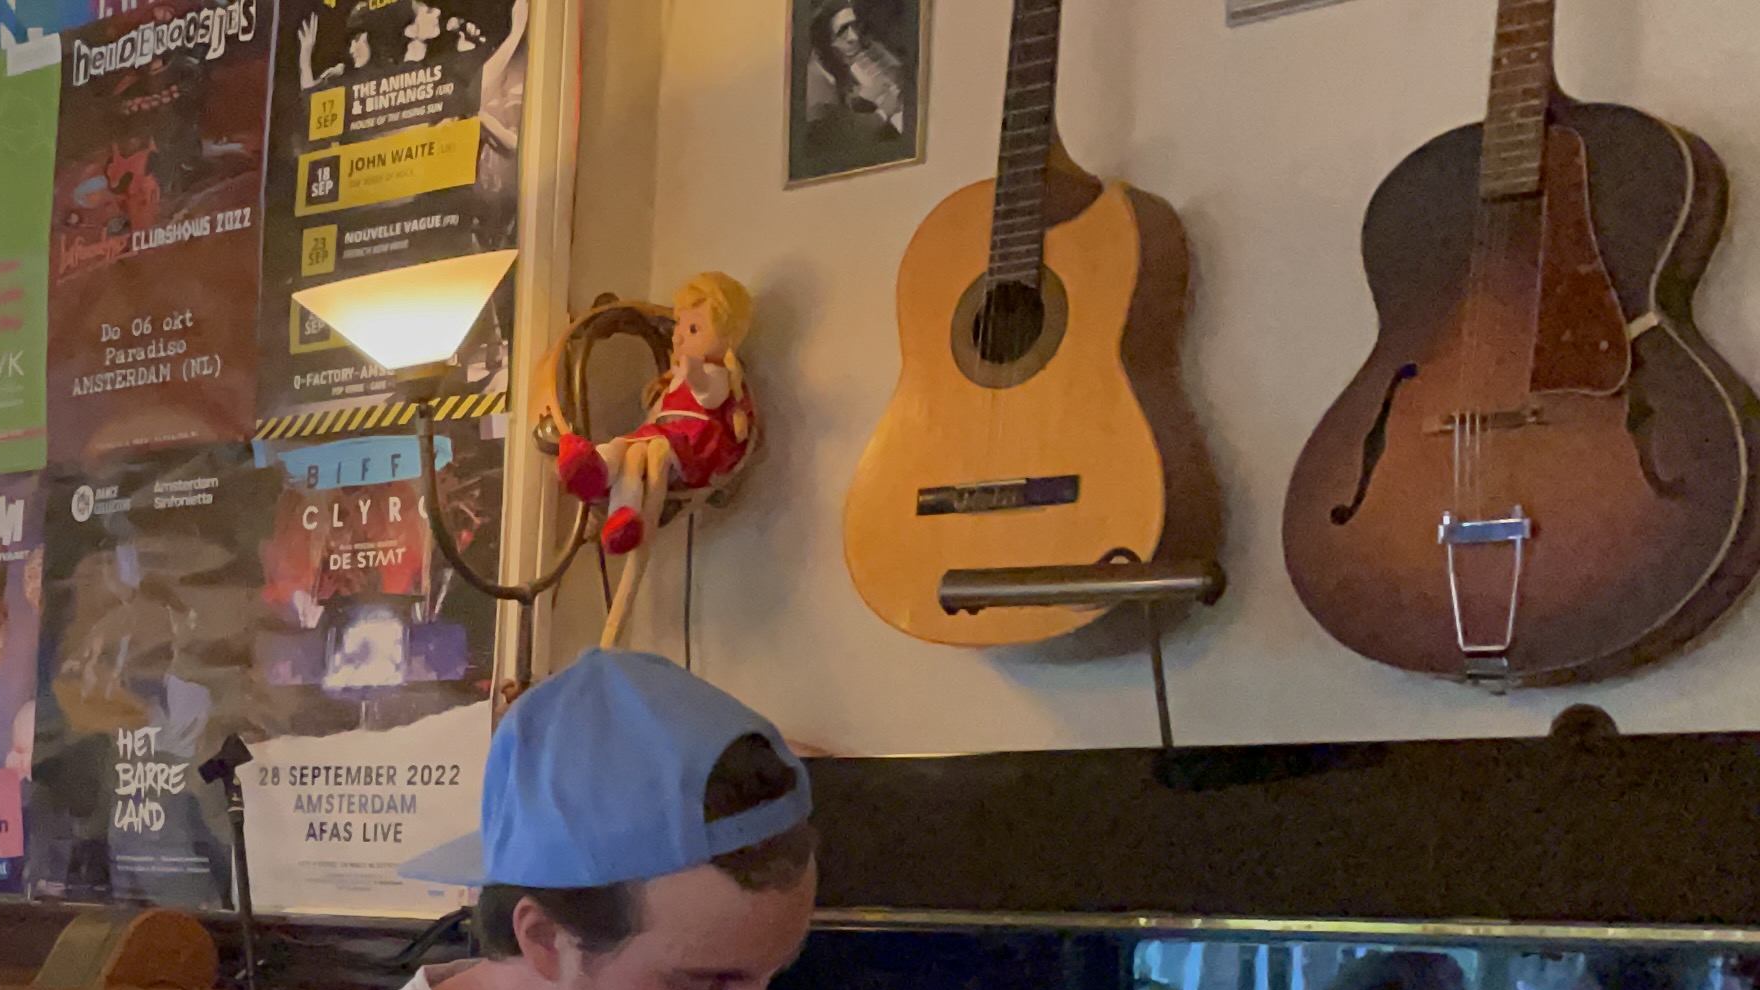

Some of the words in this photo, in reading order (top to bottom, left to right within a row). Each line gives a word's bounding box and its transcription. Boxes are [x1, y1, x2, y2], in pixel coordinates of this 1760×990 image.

[352, 80, 377, 99] THE
[379, 65, 442, 94] ANIMALS
[352, 101, 363, 115] &
[365, 83, 435, 112] BINTANGS
[316, 113, 338, 130] SEP
[348, 153, 387, 177] JOHN
[391, 141, 436, 164] WAITE
[311, 179, 334, 198] SEP
[316, 166, 331, 183] 18
[215, 207, 252, 233] 2022
[344, 222, 402, 244] NOUVELLE
[403, 214, 442, 233] VAGUE
[307, 250, 329, 266] SEP
[100, 323, 121, 342] Do
[131, 316, 153, 336] 06
[162, 309, 194, 331] okt
[104, 338, 187, 367] Paradiso
[72, 362, 171, 397] AMSTERDAM
[182, 354, 222, 382] (NL)
[306, 453, 402, 488] BIFF
[329, 553, 352, 571] DE
[116, 726, 162, 760] HET
[114, 761, 190, 798] BARRE
[258, 766, 281, 787] 28
[288, 765, 398, 787] SEPTEMBER
[406, 764, 462, 786] 2022
[114, 797, 166, 834] LAND
[293, 793, 418, 814] AMSTERDAM
[304, 821, 353, 842] AFAS
[362, 822, 404, 843] LIVE
